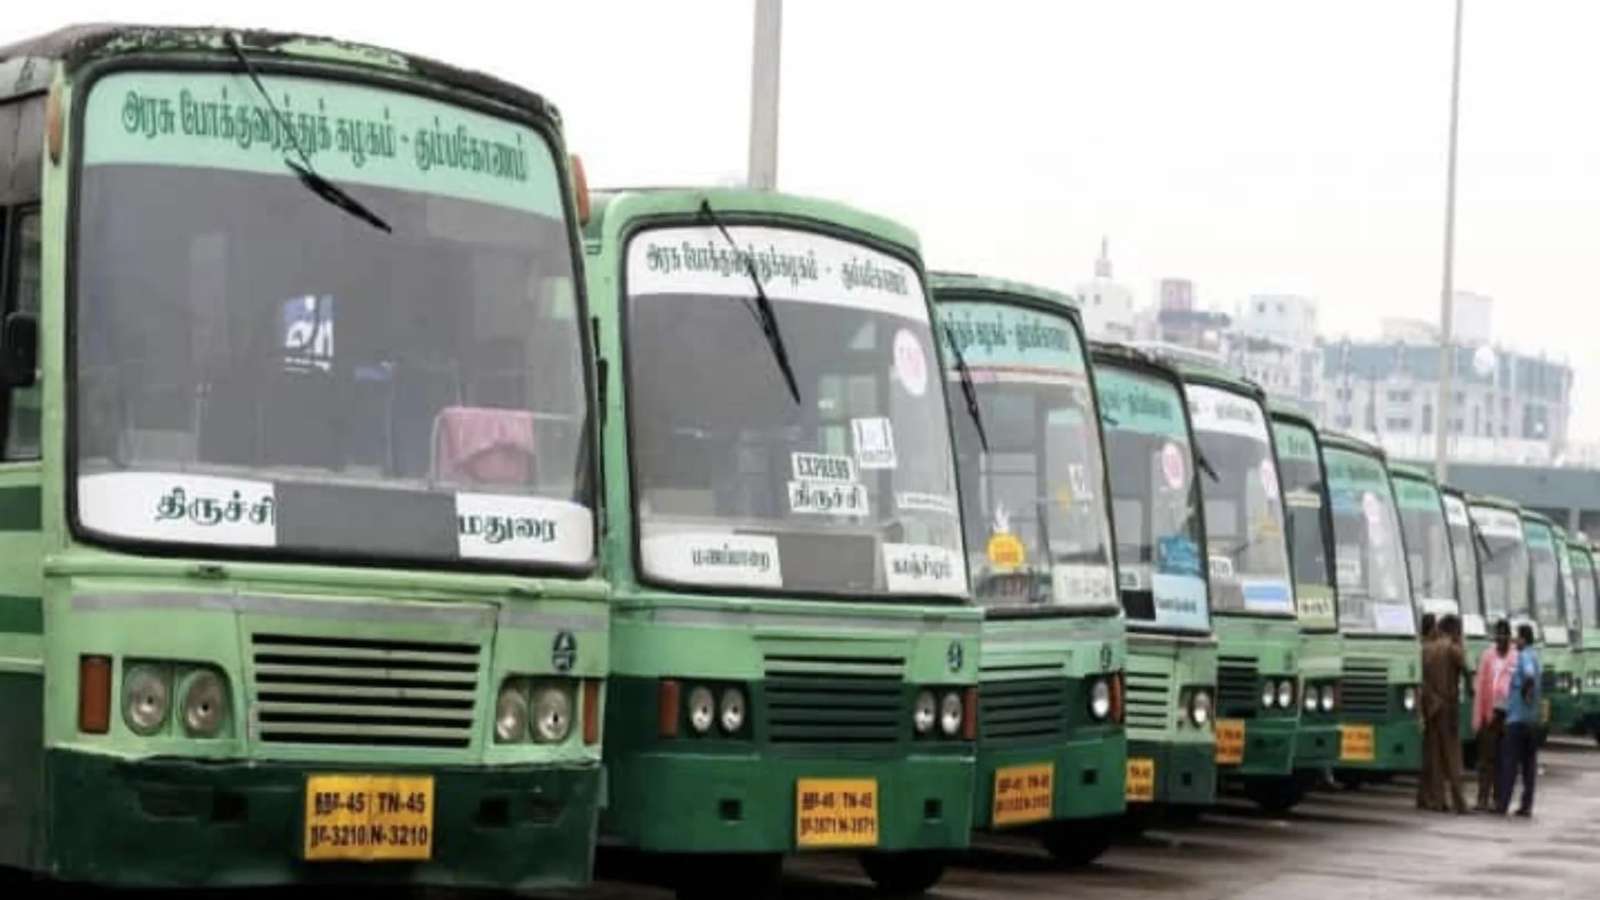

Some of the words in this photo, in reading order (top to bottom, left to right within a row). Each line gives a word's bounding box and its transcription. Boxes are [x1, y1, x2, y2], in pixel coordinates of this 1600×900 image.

[122, 90, 175, 138] அரசு
[336, 106, 396, 168] கழகம்
[797, 456, 850, 480] EXPRESS
[154, 487, 275, 527] திருச்சி
[459, 515, 557, 544] மதுரை
[378, 791, 426, 814] TN-45
[370, 825, 428, 847] N-3210
